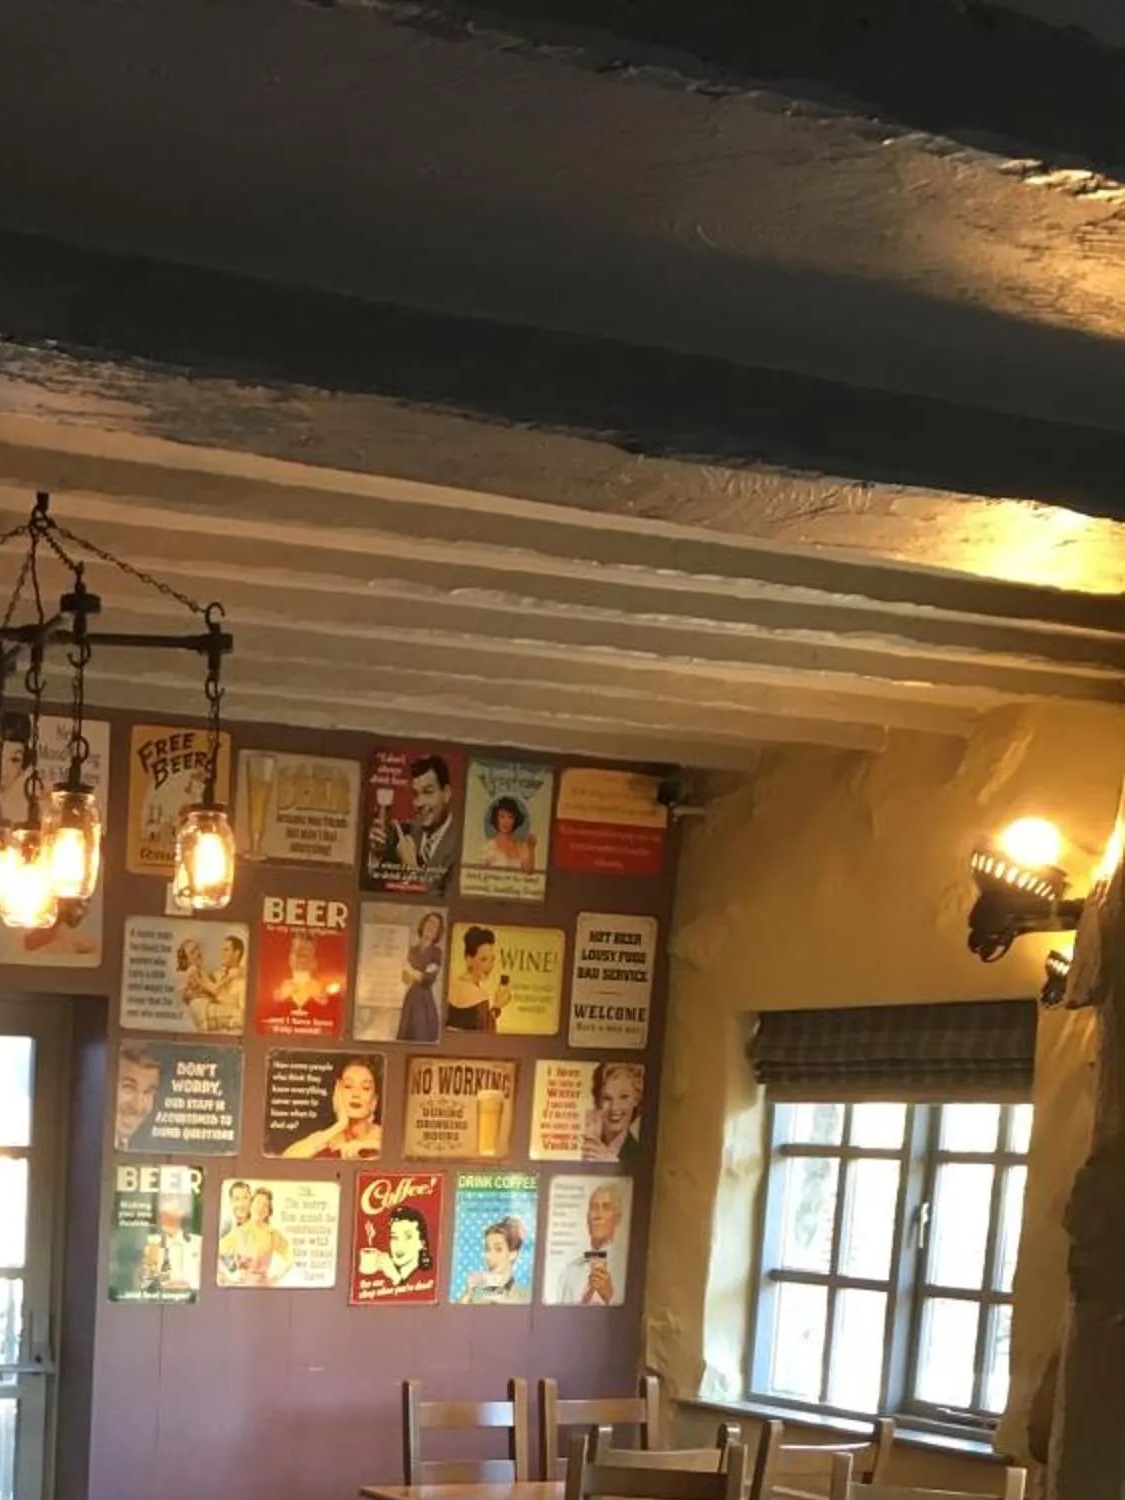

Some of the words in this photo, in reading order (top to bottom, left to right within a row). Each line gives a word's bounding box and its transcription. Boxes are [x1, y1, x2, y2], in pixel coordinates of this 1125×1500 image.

[137, 732, 196, 774] FREE
[262, 896, 349, 929] BEER
[500, 948, 558, 973] WINE!
[581, 948, 616, 963] LOUSY
[617, 951, 647, 965] FOOD
[577, 967, 600, 979] BAD
[602, 968, 649, 982] SERVICE
[574, 1003, 648, 1022] WELCOME
[176, 1061, 218, 1078] DON'T
[171, 1079, 224, 1097] WORRY,
[411, 1068, 432, 1095] NO
[437, 1065, 512, 1099] WORKING
[164, 1097, 185, 1109] OUR
[186, 1098, 214, 1111] STAFF
[422, 1107, 464, 1118] DURING
[155, 1111, 218, 1125] ACCUSTOMED
[416, 1120, 468, 1130] DRINKING
[152, 1125, 181, 1138] DUMB
[182, 1127, 235, 1142] QUESTIONS
[422, 1131, 459, 1141] HOURS
[116, 1165, 203, 1194] BEER
[458, 1175, 492, 1189] DRINK
[494, 1175, 540, 1189] COFFEE
[361, 1177, 437, 1215] Coffee!
